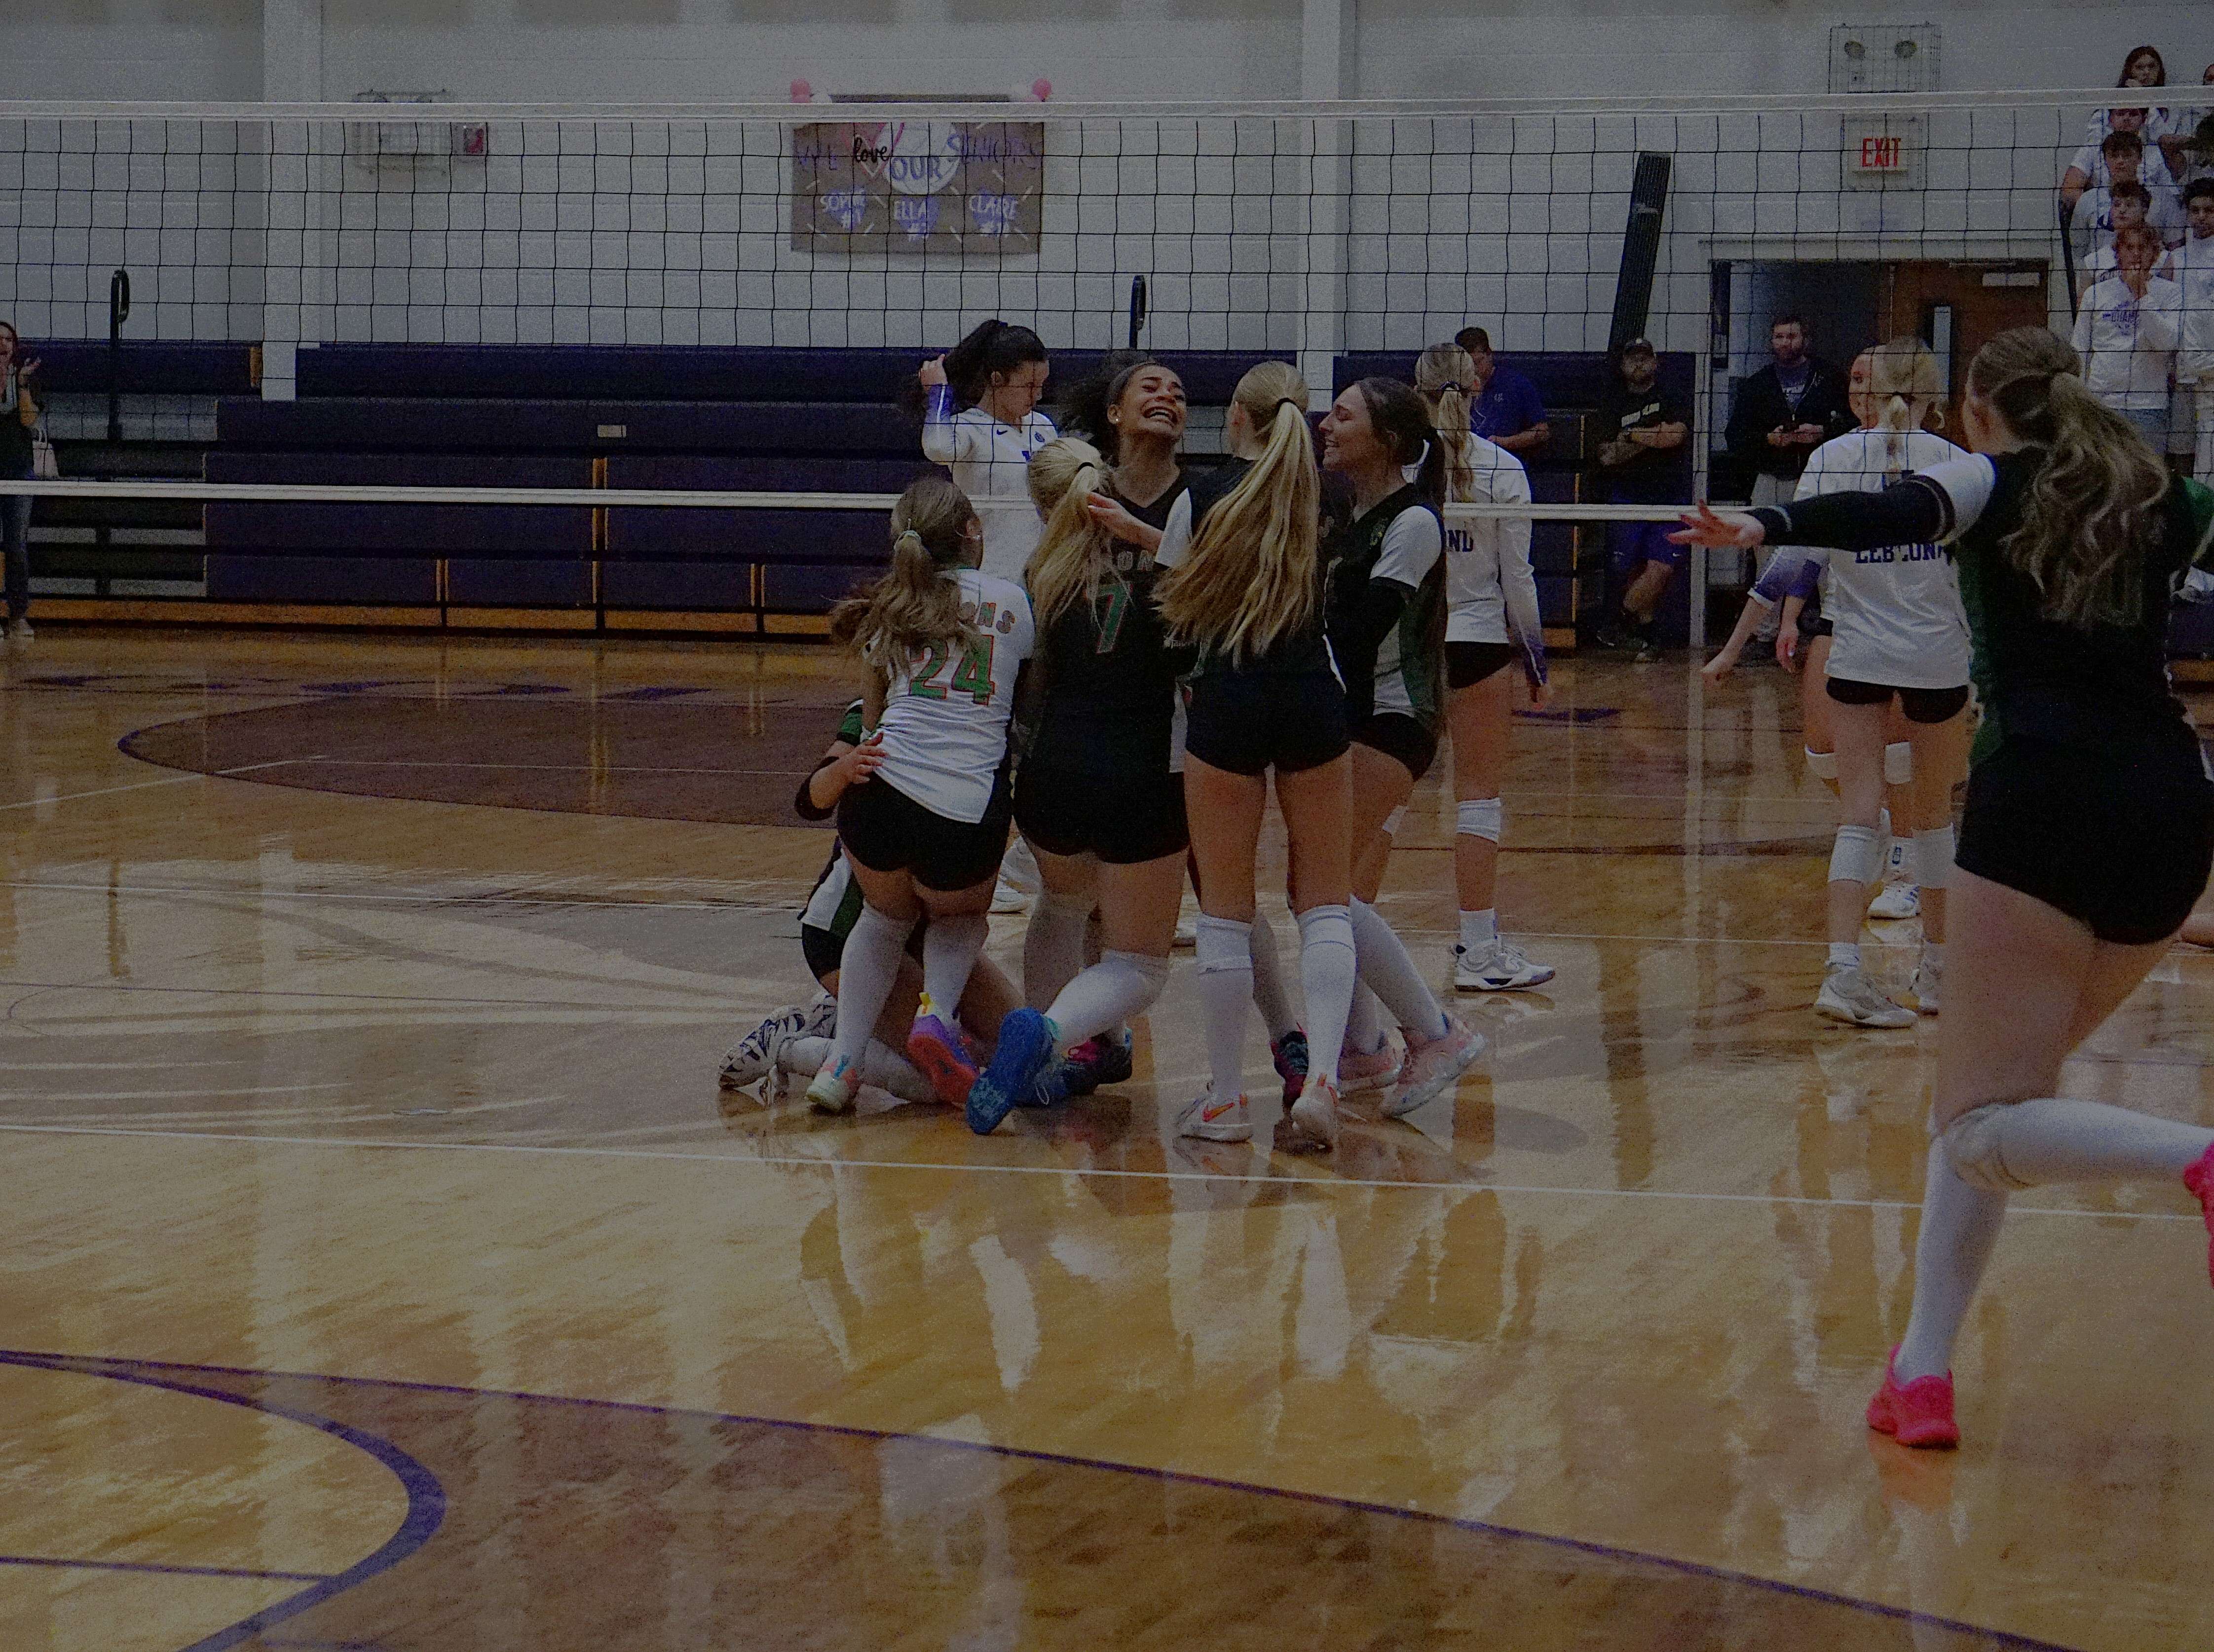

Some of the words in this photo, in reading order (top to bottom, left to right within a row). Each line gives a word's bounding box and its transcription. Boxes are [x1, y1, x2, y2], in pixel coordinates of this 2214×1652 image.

[853, 136, 889, 163] love
[890, 157, 942, 181] OUR
[1862, 138, 1901, 167] EXIT
[893, 199, 928, 221] ELLA
[1095, 580, 1134, 656] 7
[908, 634, 995, 706] 24
